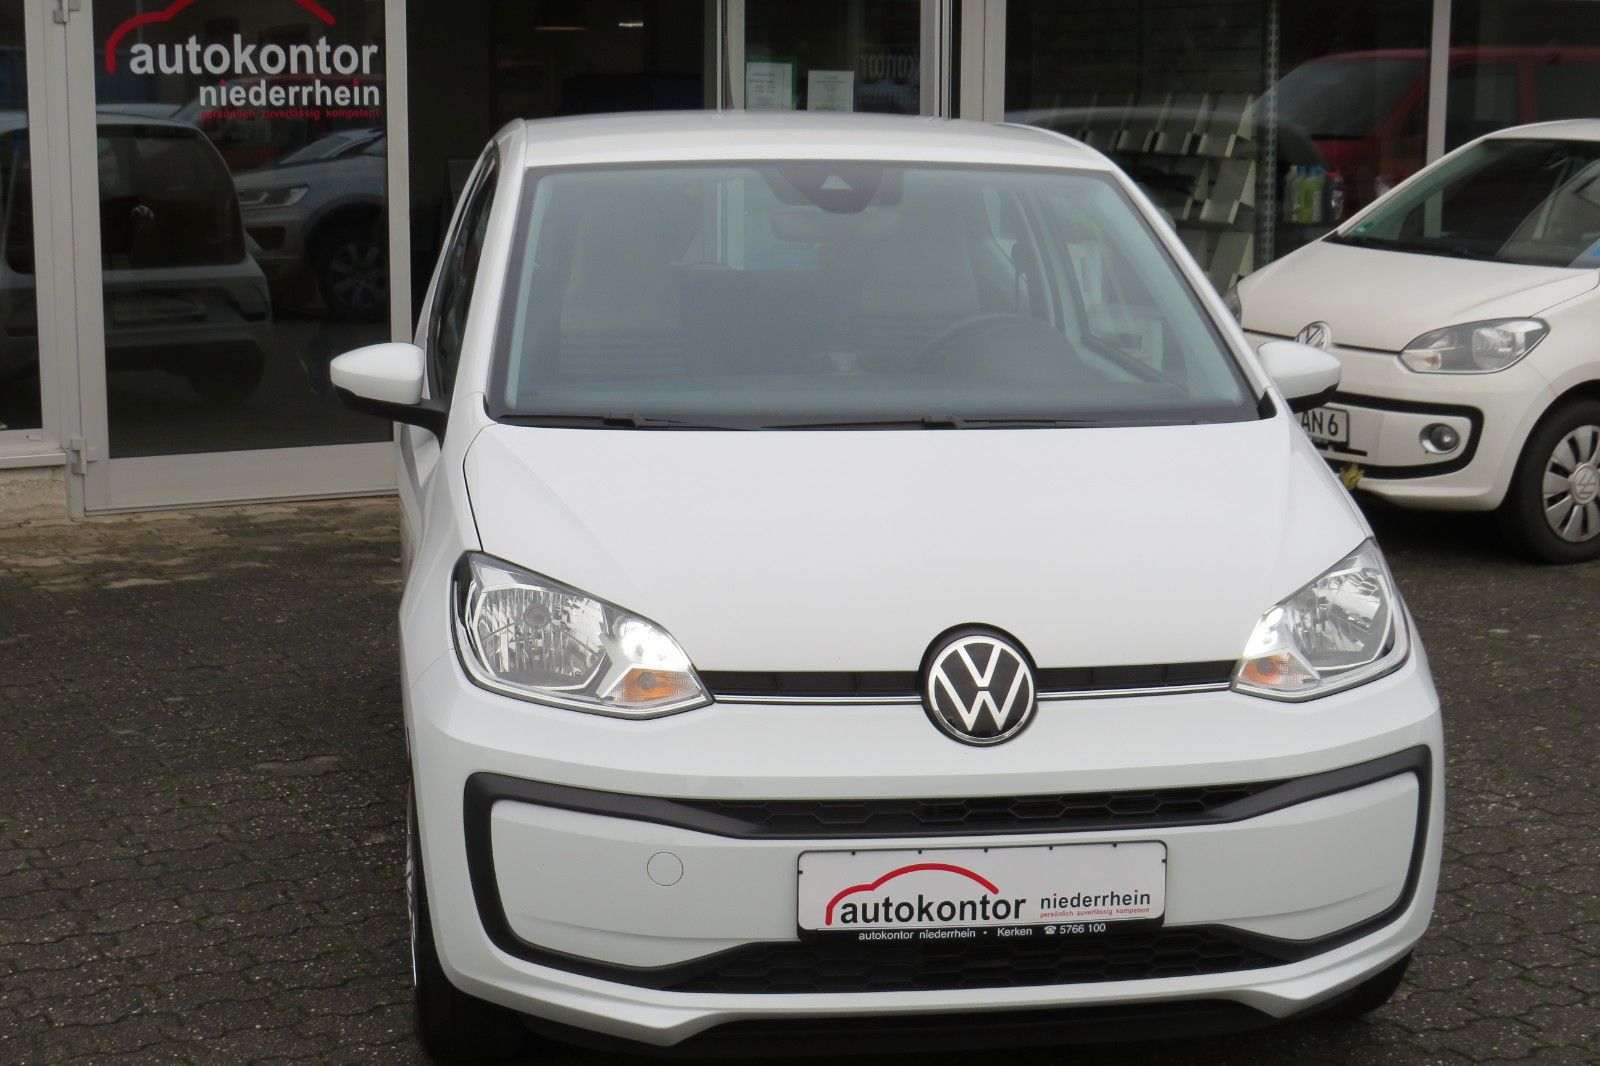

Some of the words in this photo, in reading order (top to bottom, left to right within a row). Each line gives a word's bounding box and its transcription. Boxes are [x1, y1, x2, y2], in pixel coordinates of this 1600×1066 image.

[129, 33, 379, 76] autokontor
[199, 80, 380, 107] niederrhein
[325, 107, 380, 119] kompetent
[1327, 414, 1340, 436] 6
[840, 894, 1027, 924] autokontor
[1040, 889, 1151, 909] niederrhein
[858, 930, 914, 941] autokontor
[919, 928, 976, 940] niederrhein
[997, 927, 1033, 937] Kerken
[1059, 924, 1085, 934] 5766
[1088, 923, 1106, 933] 100
